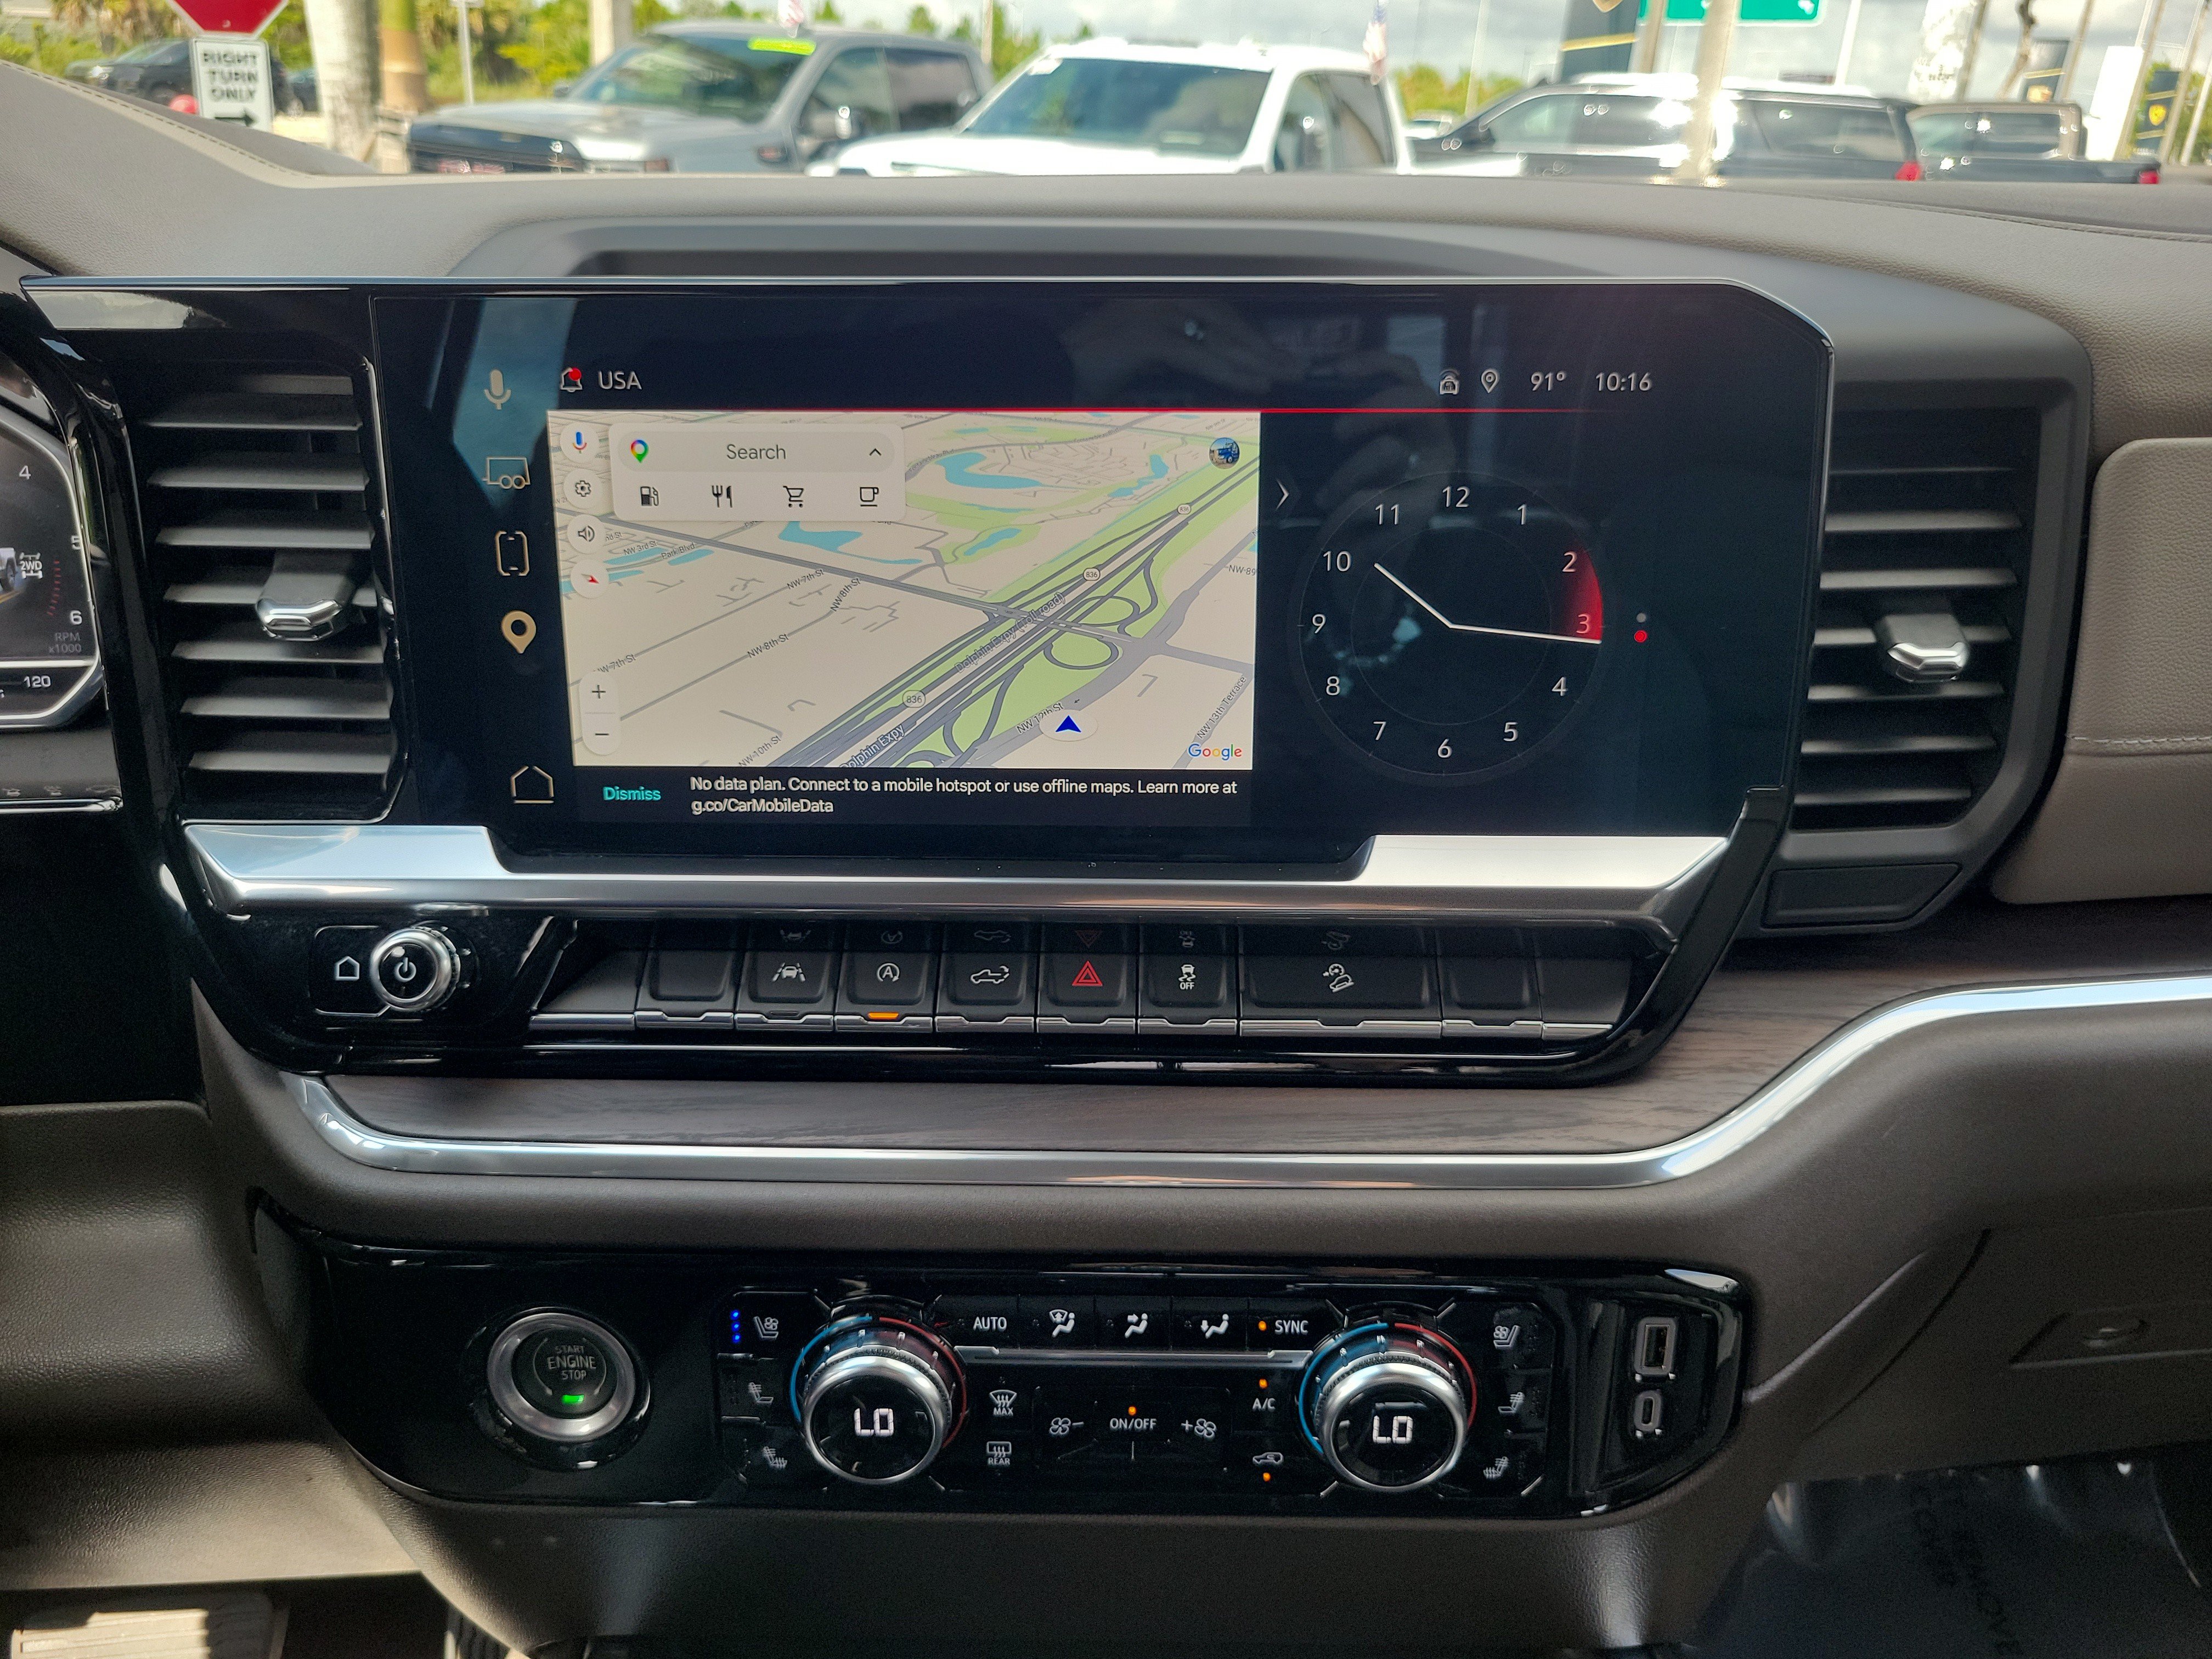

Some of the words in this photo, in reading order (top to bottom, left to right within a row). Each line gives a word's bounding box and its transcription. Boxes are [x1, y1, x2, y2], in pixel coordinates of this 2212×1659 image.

[203, 52, 257, 65] RIGHT
[209, 70, 258, 82] TURN
[211, 87, 256, 100] ONLY
[599, 371, 642, 390] USA
[1530, 371, 1566, 391] 91°
[1595, 372, 1652, 391] 10:16
[726, 443, 786, 460] Search
[19, 466, 31, 479] 4
[1442, 486, 1470, 507] 12
[1375, 504, 1399, 525] 11
[1517, 504, 1527, 525] 1
[624, 547, 636, 556] NW
[636, 543, 648, 552] 3rd
[661, 550, 678, 560] Park
[678, 542, 696, 554] Blvd
[20, 561, 42, 571] 2WD
[1229, 565, 1244, 574] NW
[1323, 551, 1351, 572] 10
[1562, 551, 1577, 572] 2
[787, 579, 800, 589] NW
[802, 573, 815, 583] 7th
[815, 569, 824, 577] St
[831, 596, 843, 612] NW
[839, 584, 853, 597] 8th
[851, 578, 860, 586] St
[69, 610, 83, 625] 6
[1312, 613, 1327, 634] 9
[1576, 613, 1590, 634] 3
[55, 632, 81, 642] RPM
[955, 646, 993, 673] Dolphin
[991, 633, 1017, 650] Expy
[1039, 592, 1066, 616] road)
[48, 643, 82, 653] x1000
[747, 645, 763, 658] NW
[764, 639, 778, 650] 8th
[779, 633, 789, 642] St
[610, 659, 626, 670] 7th
[626, 654, 636, 663] St
[23, 675, 52, 689] 120
[1325, 676, 1341, 696] 8
[1551, 676, 1567, 696] 4
[906, 696, 922, 704] 836
[1197, 723, 1211, 739] NW
[1209, 706, 1226, 724] 13th
[1222, 676, 1246, 705] Terrace
[1017, 719, 1033, 733] NW
[1053, 702, 1064, 711] St
[877, 724, 905, 747] Expy
[1373, 721, 1387, 741] 7
[1503, 722, 1519, 742] 5
[738, 754, 753, 766] NW
[753, 742, 772, 757] 10th
[771, 735, 781, 744] St
[1188, 743, 1243, 761] Google
[1437, 738, 1452, 758] 6
[603, 786, 662, 802] Dismiss
[690, 776, 713, 791] No
[714, 776, 748, 791] data
[750, 776, 786, 794] plan.
[788, 777, 850, 791] Connect
[852, 778, 868, 791] to
[871, 781, 881, 792] a
[884, 777, 933, 792] mobile
[936, 777, 992, 795] hotspot
[995, 782, 1011, 792] or
[1013, 781, 1039, 793] use
[1042, 778, 1088, 793] offline
[1091, 782, 1134, 797] maps.
[1138, 780, 1178, 794] Learn
[1182, 783, 1220, 794] more
[1222, 781, 1238, 794] at
[691, 798, 834, 815] g.co/CarMobileData
[1180, 982, 1195, 990] OFF
[973, 1316, 1007, 1330] AUTO
[1274, 1319, 1309, 1334] SYNC
[555, 1345, 585, 1355] START
[547, 1355, 597, 1370] ENGINE
[561, 1369, 587, 1380] STOP
[993, 1407, 1014, 1417] MAX
[1252, 1397, 1276, 1410] A/C
[854, 1407, 894, 1436] LO
[1109, 1418, 1157, 1430] ON/OFF
[1372, 1415, 1413, 1443] LO
[988, 1456, 1011, 1466] REAR
